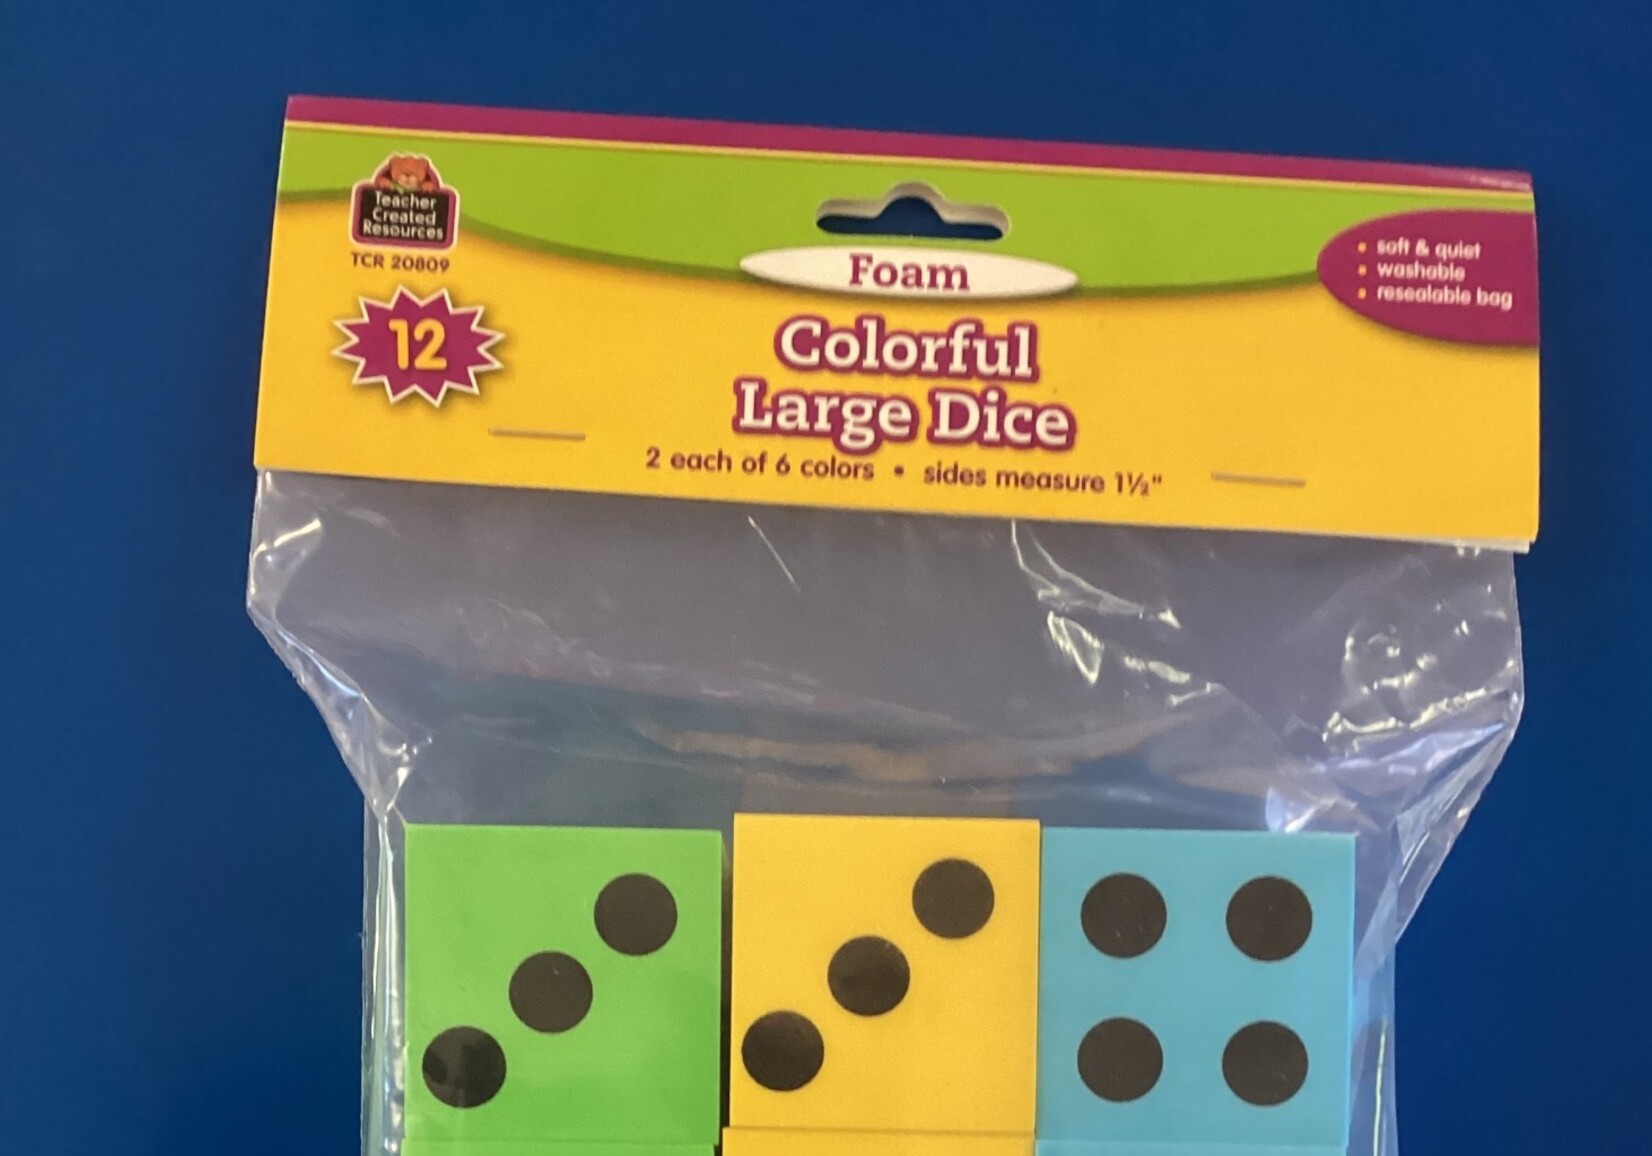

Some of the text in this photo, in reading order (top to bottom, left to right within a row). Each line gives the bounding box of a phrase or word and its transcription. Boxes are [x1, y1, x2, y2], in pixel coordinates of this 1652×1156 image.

[375, 190, 437, 210] Teacher
[372, 207, 436, 226] Created
[363, 220, 443, 240] Resources
[1377, 237, 1481, 261] soft & quiet
[351, 252, 450, 273] TCR 20809
[848, 254, 969, 291] Foam
[1377, 261, 1466, 282] washable
[1377, 285, 1512, 311] resealable bag
[388, 318, 448, 371] 12
[779, 318, 1034, 378] Colorful
[737, 381, 1071, 450] Large Dice
[645, 448, 660, 469] 2
[670, 448, 732, 473] each
[742, 450, 767, 474] of
[775, 453, 791, 476] 6
[800, 455, 874, 480] colors
[923, 460, 986, 488] sides
[996, 469, 1105, 493] measure
